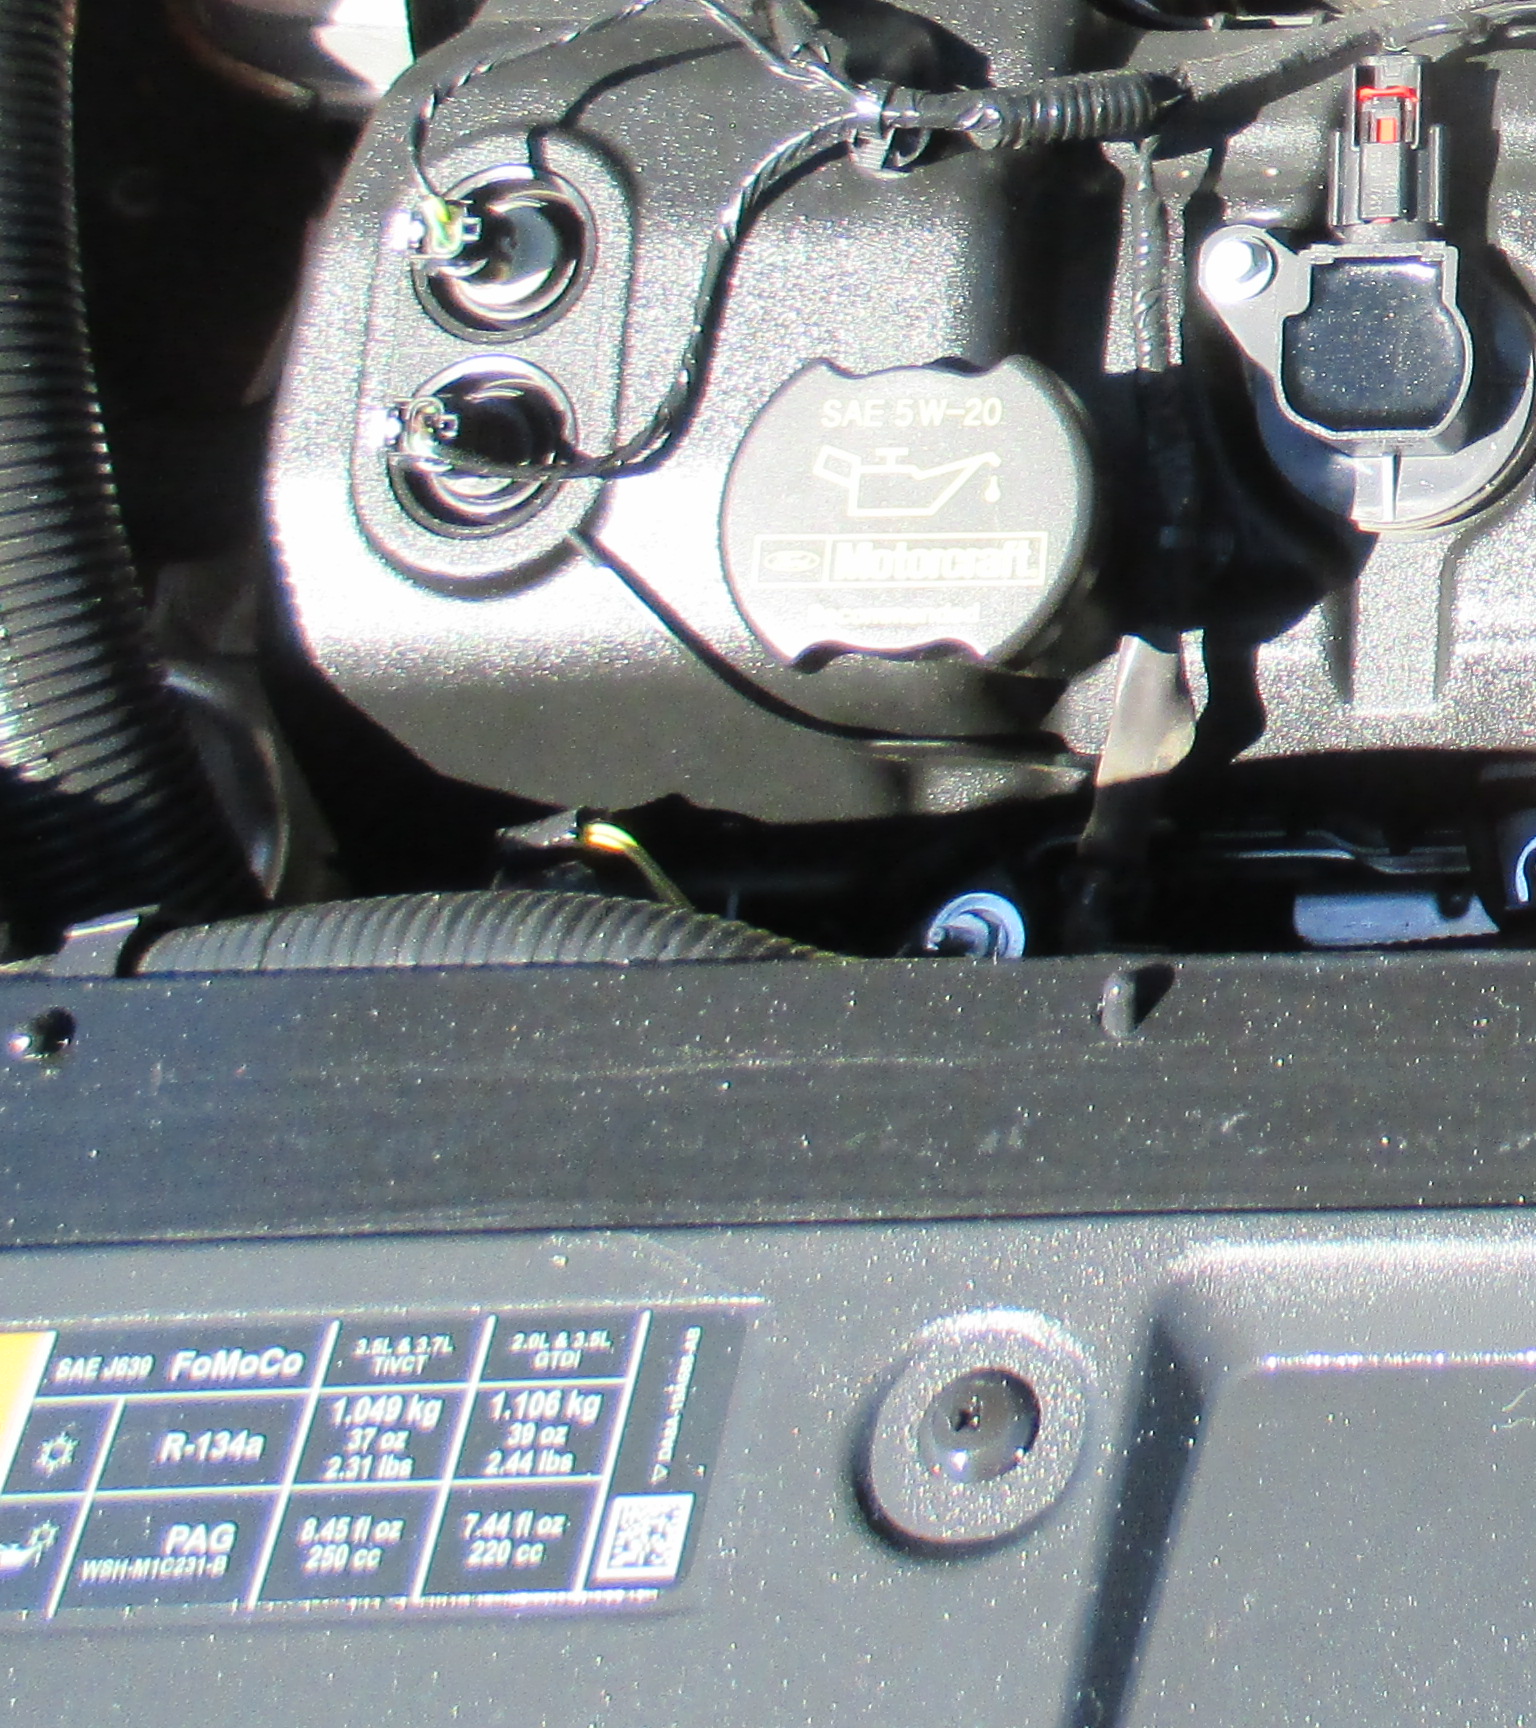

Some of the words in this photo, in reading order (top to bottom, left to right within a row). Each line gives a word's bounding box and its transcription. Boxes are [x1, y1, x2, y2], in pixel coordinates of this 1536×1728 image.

[820, 398, 885, 429] SAE
[894, 396, 1003, 428] 5W-20
[53, 1355, 103, 1383] SAE
[102, 1354, 156, 1380] J639
[168, 1345, 305, 1382] FoMoCo
[329, 1394, 404, 1428] 1.049
[405, 1393, 445, 1432] kg
[489, 1389, 563, 1422] 1.106
[564, 1388, 604, 1426] kg
[157, 1428, 267, 1464] R-134a
[345, 1427, 379, 1454] 37
[380, 1430, 411, 1452] oz
[505, 1421, 538, 1448] 39
[539, 1424, 570, 1447] oz
[321, 1454, 374, 1480] 2.31
[376, 1454, 414, 1478] lbs
[482, 1449, 536, 1477] 2.44
[536, 1449, 575, 1474] lbs
[162, 1520, 240, 1556] PAG
[299, 1514, 353, 1545] 8.45
[374, 1518, 405, 1542] oz
[462, 1510, 513, 1540] 7.44
[535, 1513, 568, 1538] oz
[303, 1542, 351, 1572] 250
[352, 1547, 383, 1571] cc
[465, 1538, 513, 1568] 220
[514, 1542, 547, 1565] cc
